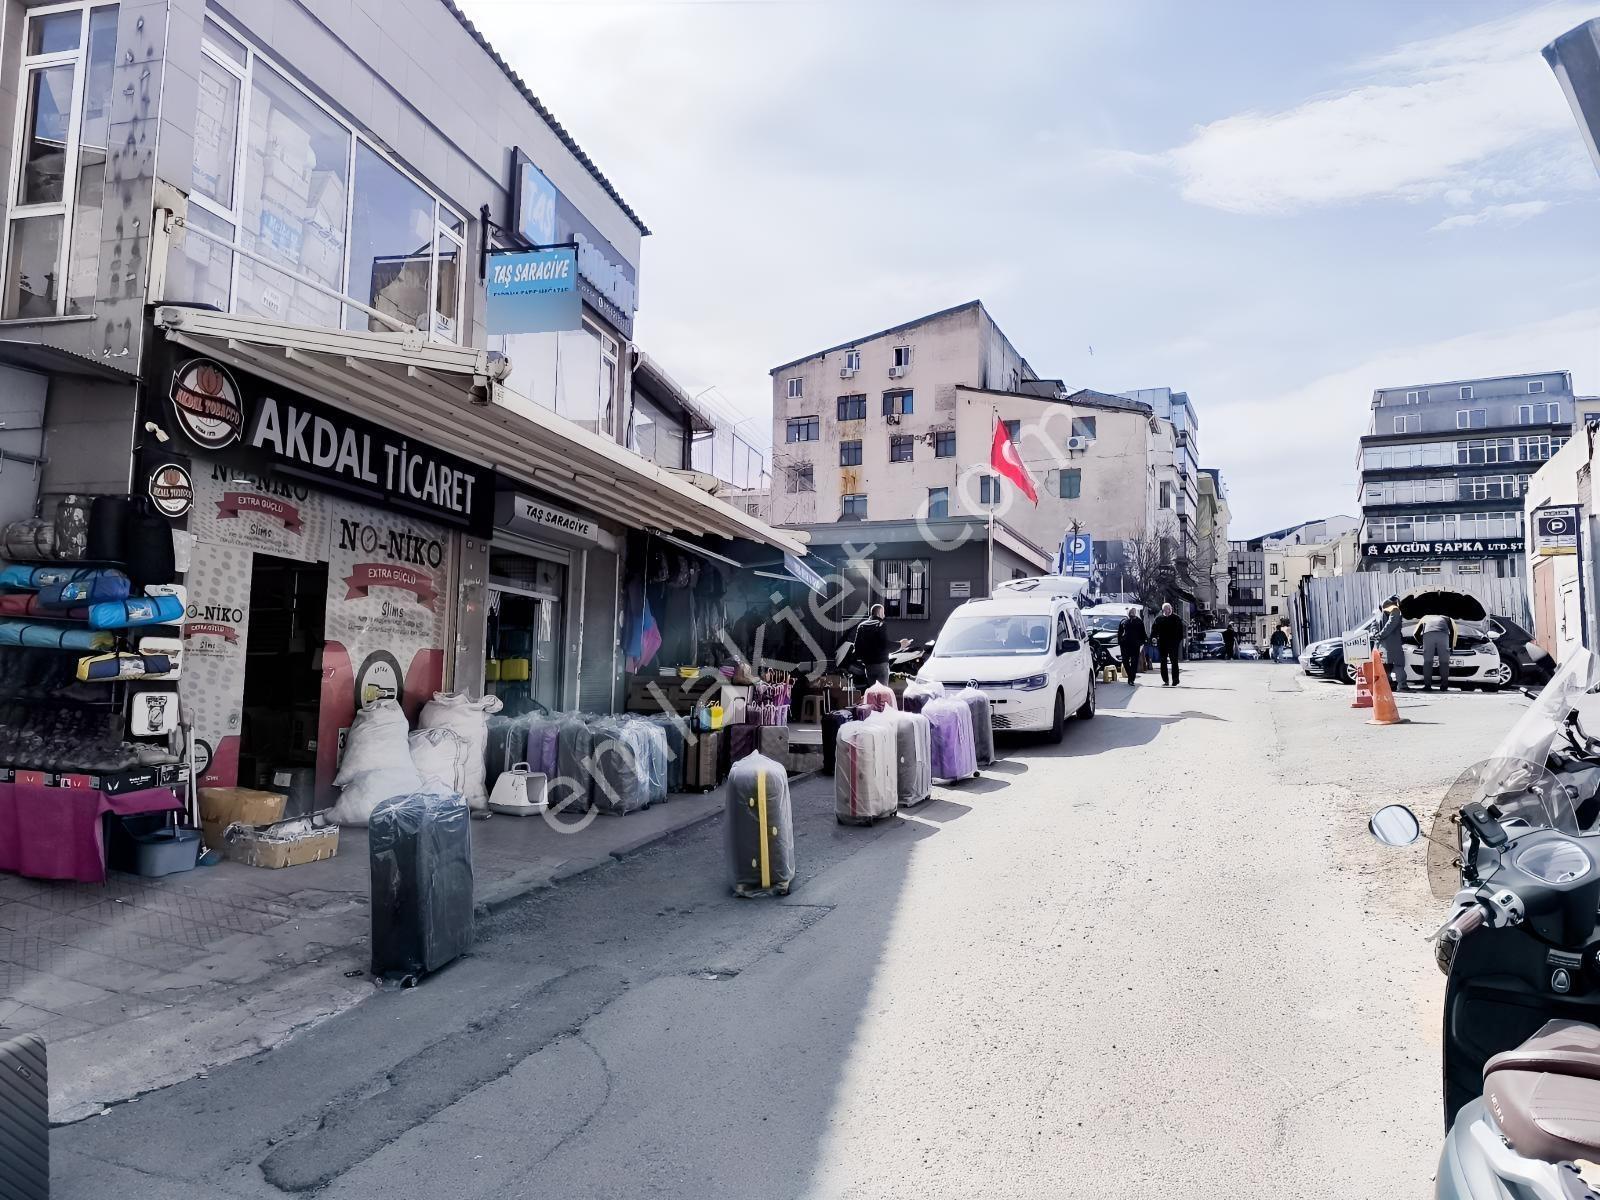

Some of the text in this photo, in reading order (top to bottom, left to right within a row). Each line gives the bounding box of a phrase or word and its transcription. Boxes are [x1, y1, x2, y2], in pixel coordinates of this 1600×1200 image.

[494, 254, 570, 288] TAŞ SARACİYE
[252, 397, 476, 515] AKDAL TİCARET
[526, 505, 589, 535] TAŞ SARACİYE
[338, 518, 443, 569] NO-NİKO
[1383, 541, 1431, 555] AYGÜN
[1434, 541, 1484, 555] ŞAPKA
[1487, 542, 1526, 552] LTD.ŞT
[368, 568, 392, 579] EXTRA
[186, 604, 243, 623] O-NİKO
